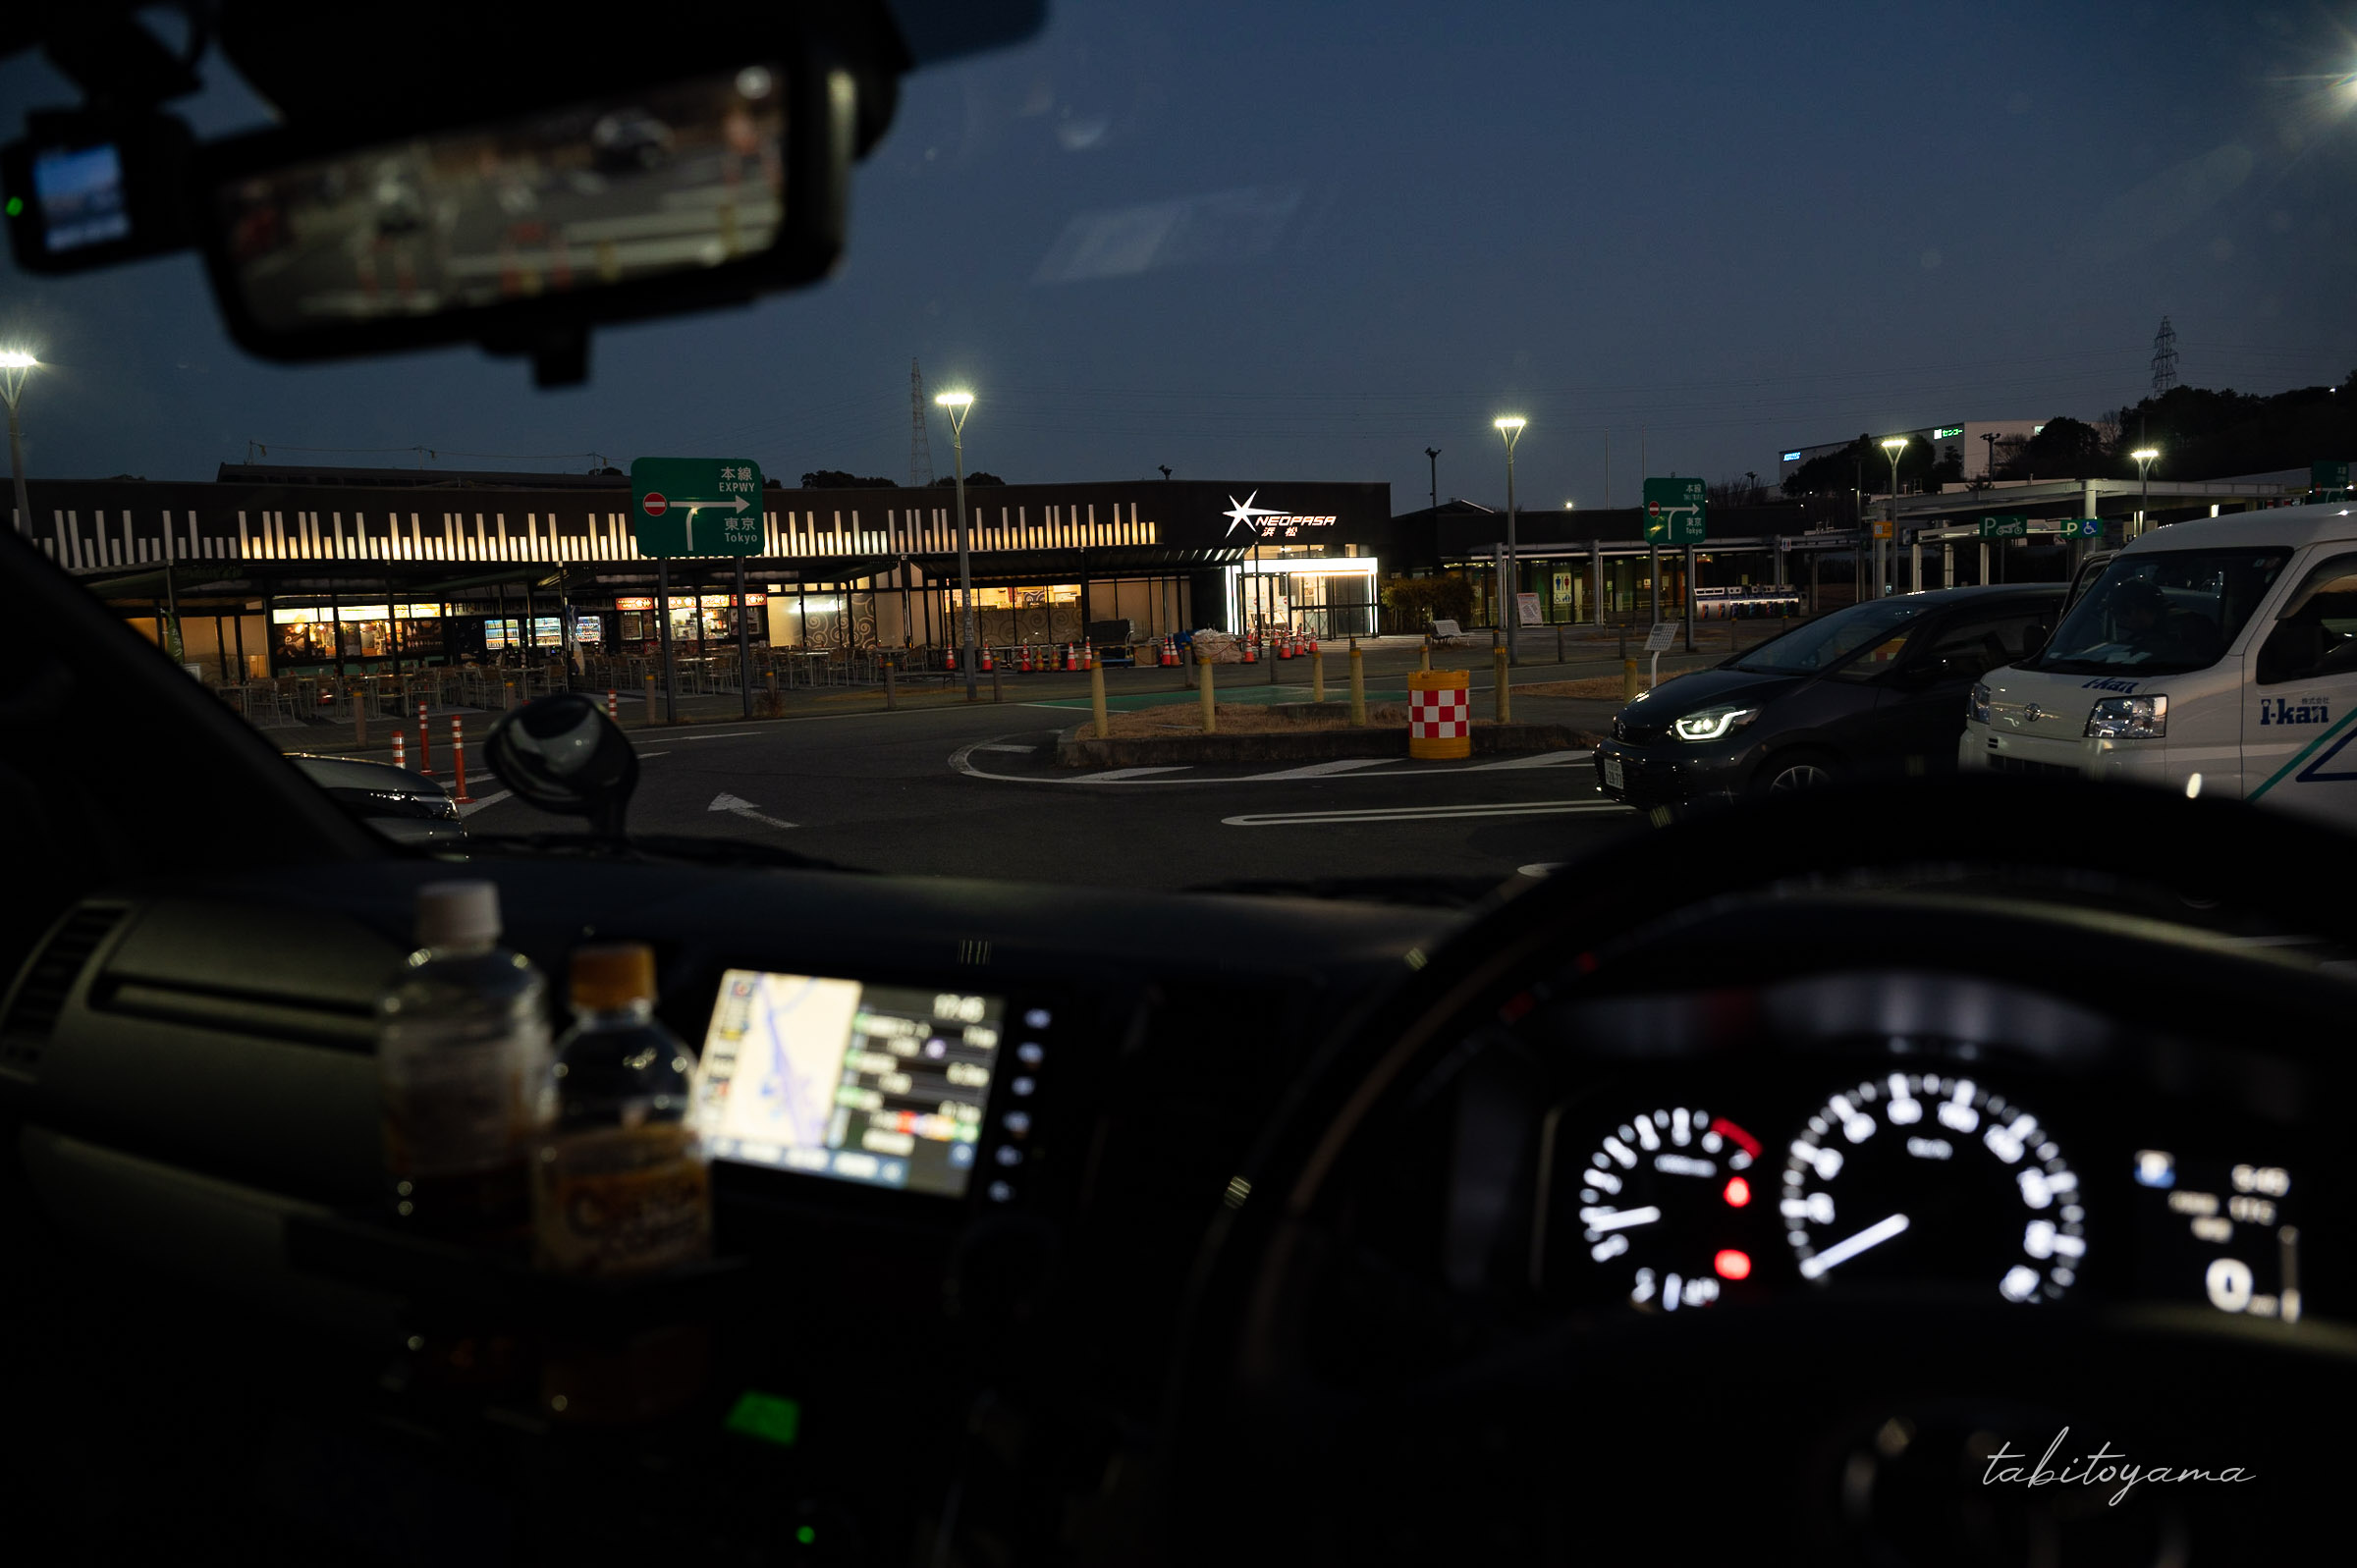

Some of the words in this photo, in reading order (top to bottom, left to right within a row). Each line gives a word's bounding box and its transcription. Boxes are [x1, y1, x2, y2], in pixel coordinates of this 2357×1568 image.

[1942, 428, 1963, 438] センコー
[721, 466, 753, 481] 本線
[719, 482, 755, 492] EXPWY
[724, 516, 756, 531] 東京
[1255, 515, 1337, 526] NEOPASA
[1686, 516, 1702, 526] 東京
[1261, 526, 1298, 537] 浜松
[1685, 527, 1703, 536] Tokyo
[1984, 517, 1997, 536] P
[2066, 522, 2078, 535] P
[725, 532, 757, 544] Tokyo
[2301, 696, 2330, 705] 株式会社
[2261, 698, 2329, 725] i-kan
